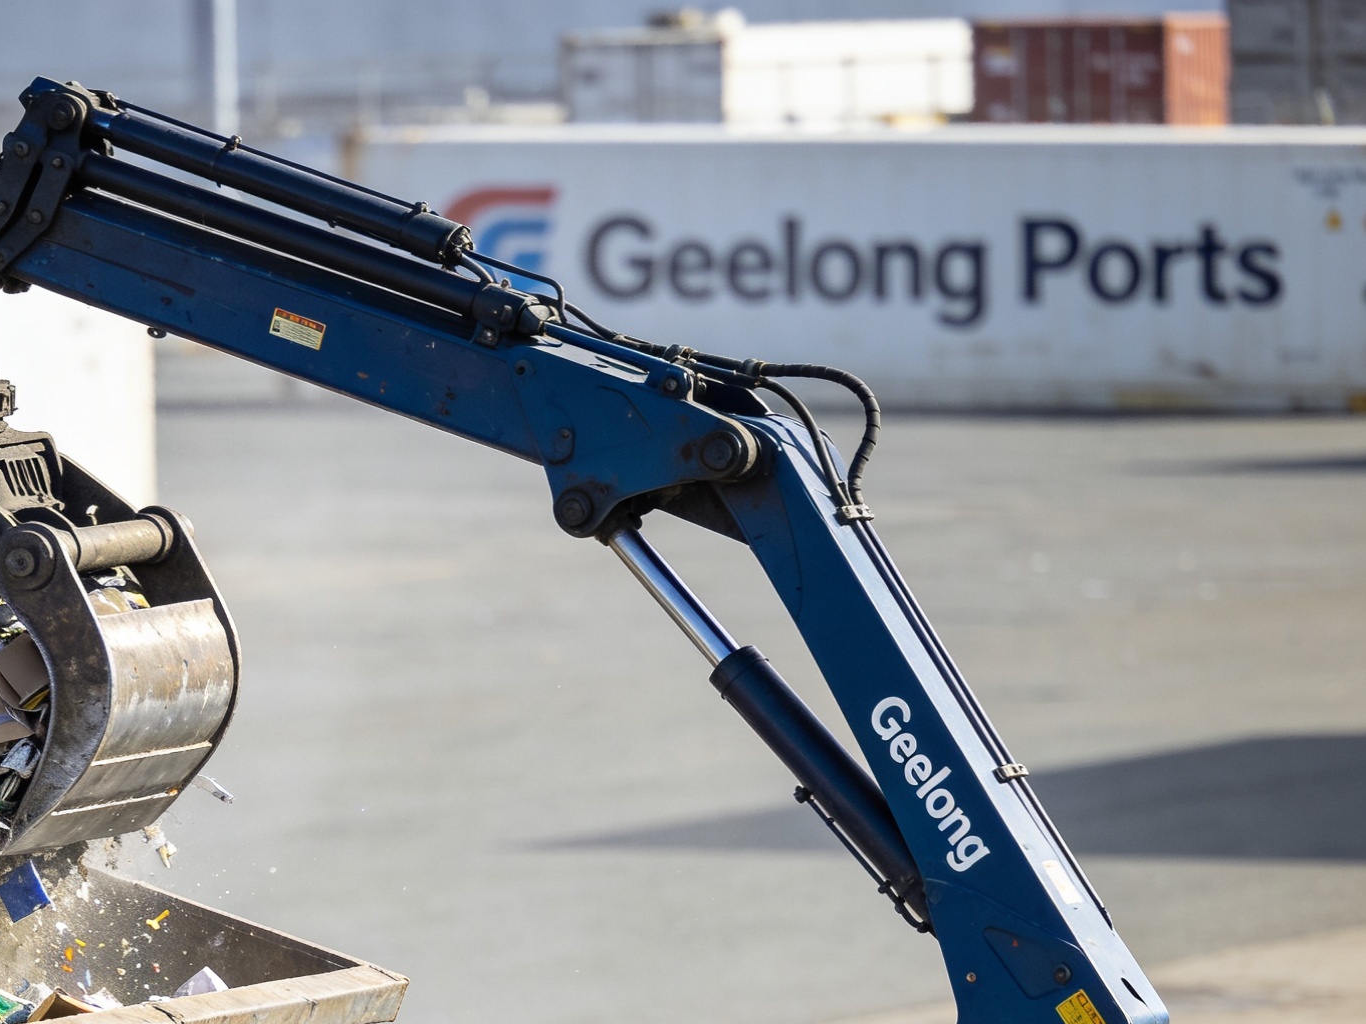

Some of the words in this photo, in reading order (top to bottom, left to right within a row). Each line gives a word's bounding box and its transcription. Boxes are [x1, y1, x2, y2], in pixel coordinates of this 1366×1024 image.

[585, 212, 987, 329] Geelong
[1020, 214, 1283, 307] Ports
[871, 696, 991, 872] Geelong
